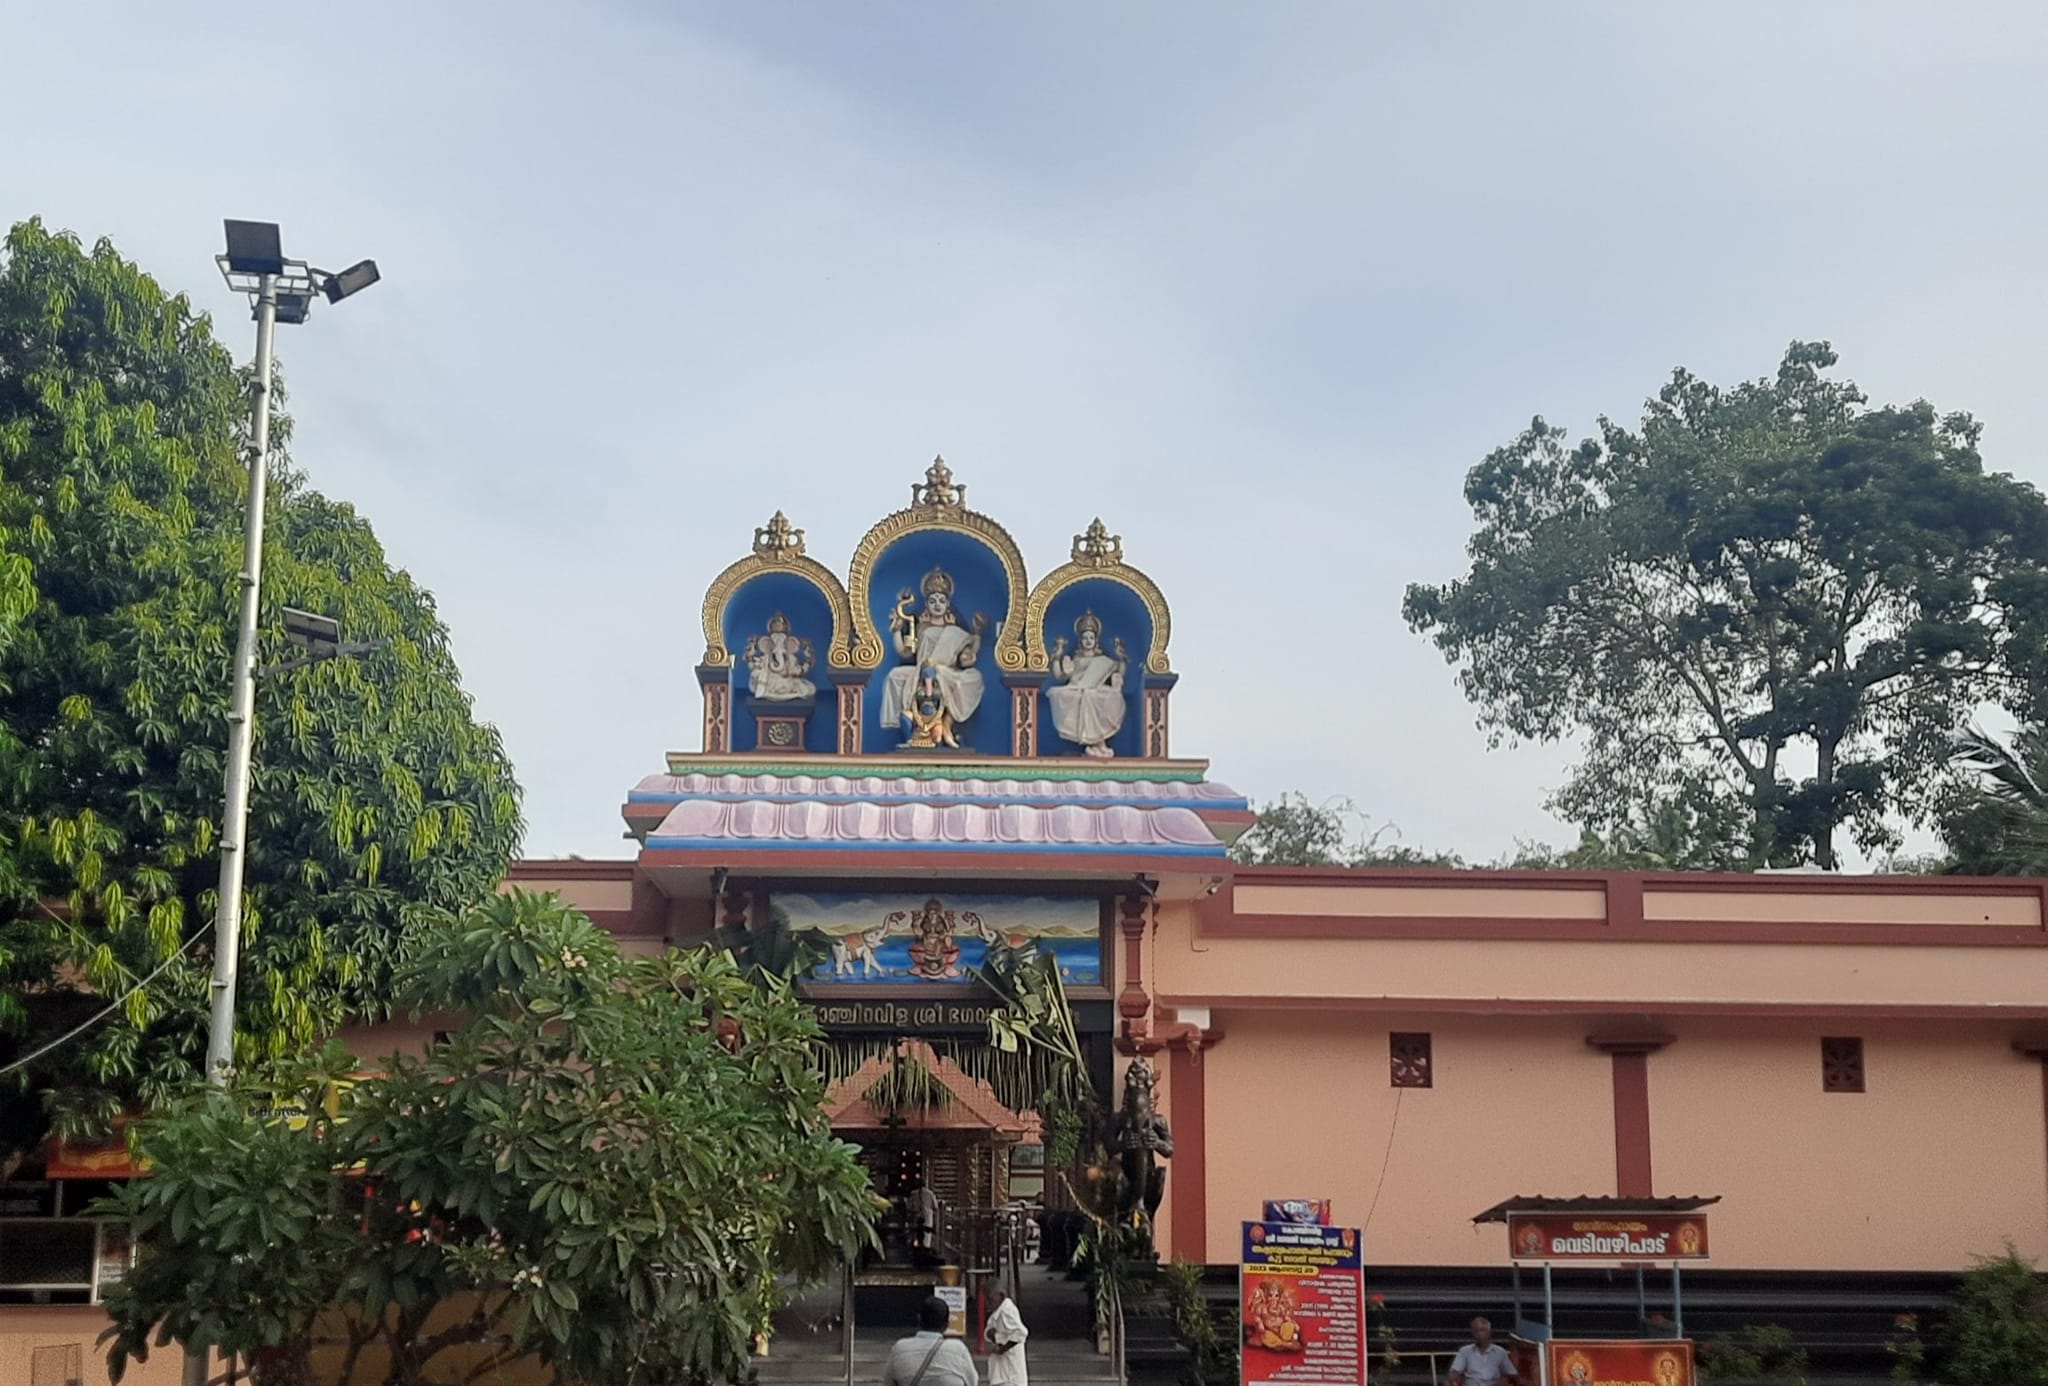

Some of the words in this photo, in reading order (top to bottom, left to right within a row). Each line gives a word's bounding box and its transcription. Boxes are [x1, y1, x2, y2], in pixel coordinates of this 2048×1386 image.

[816, 1002, 908, 1028] ാഞ്ചിറവിള
[913, 1002, 943, 1027] ശ്രീ
[1551, 1232, 1670, 1254] വെടിവഴിപാട്
